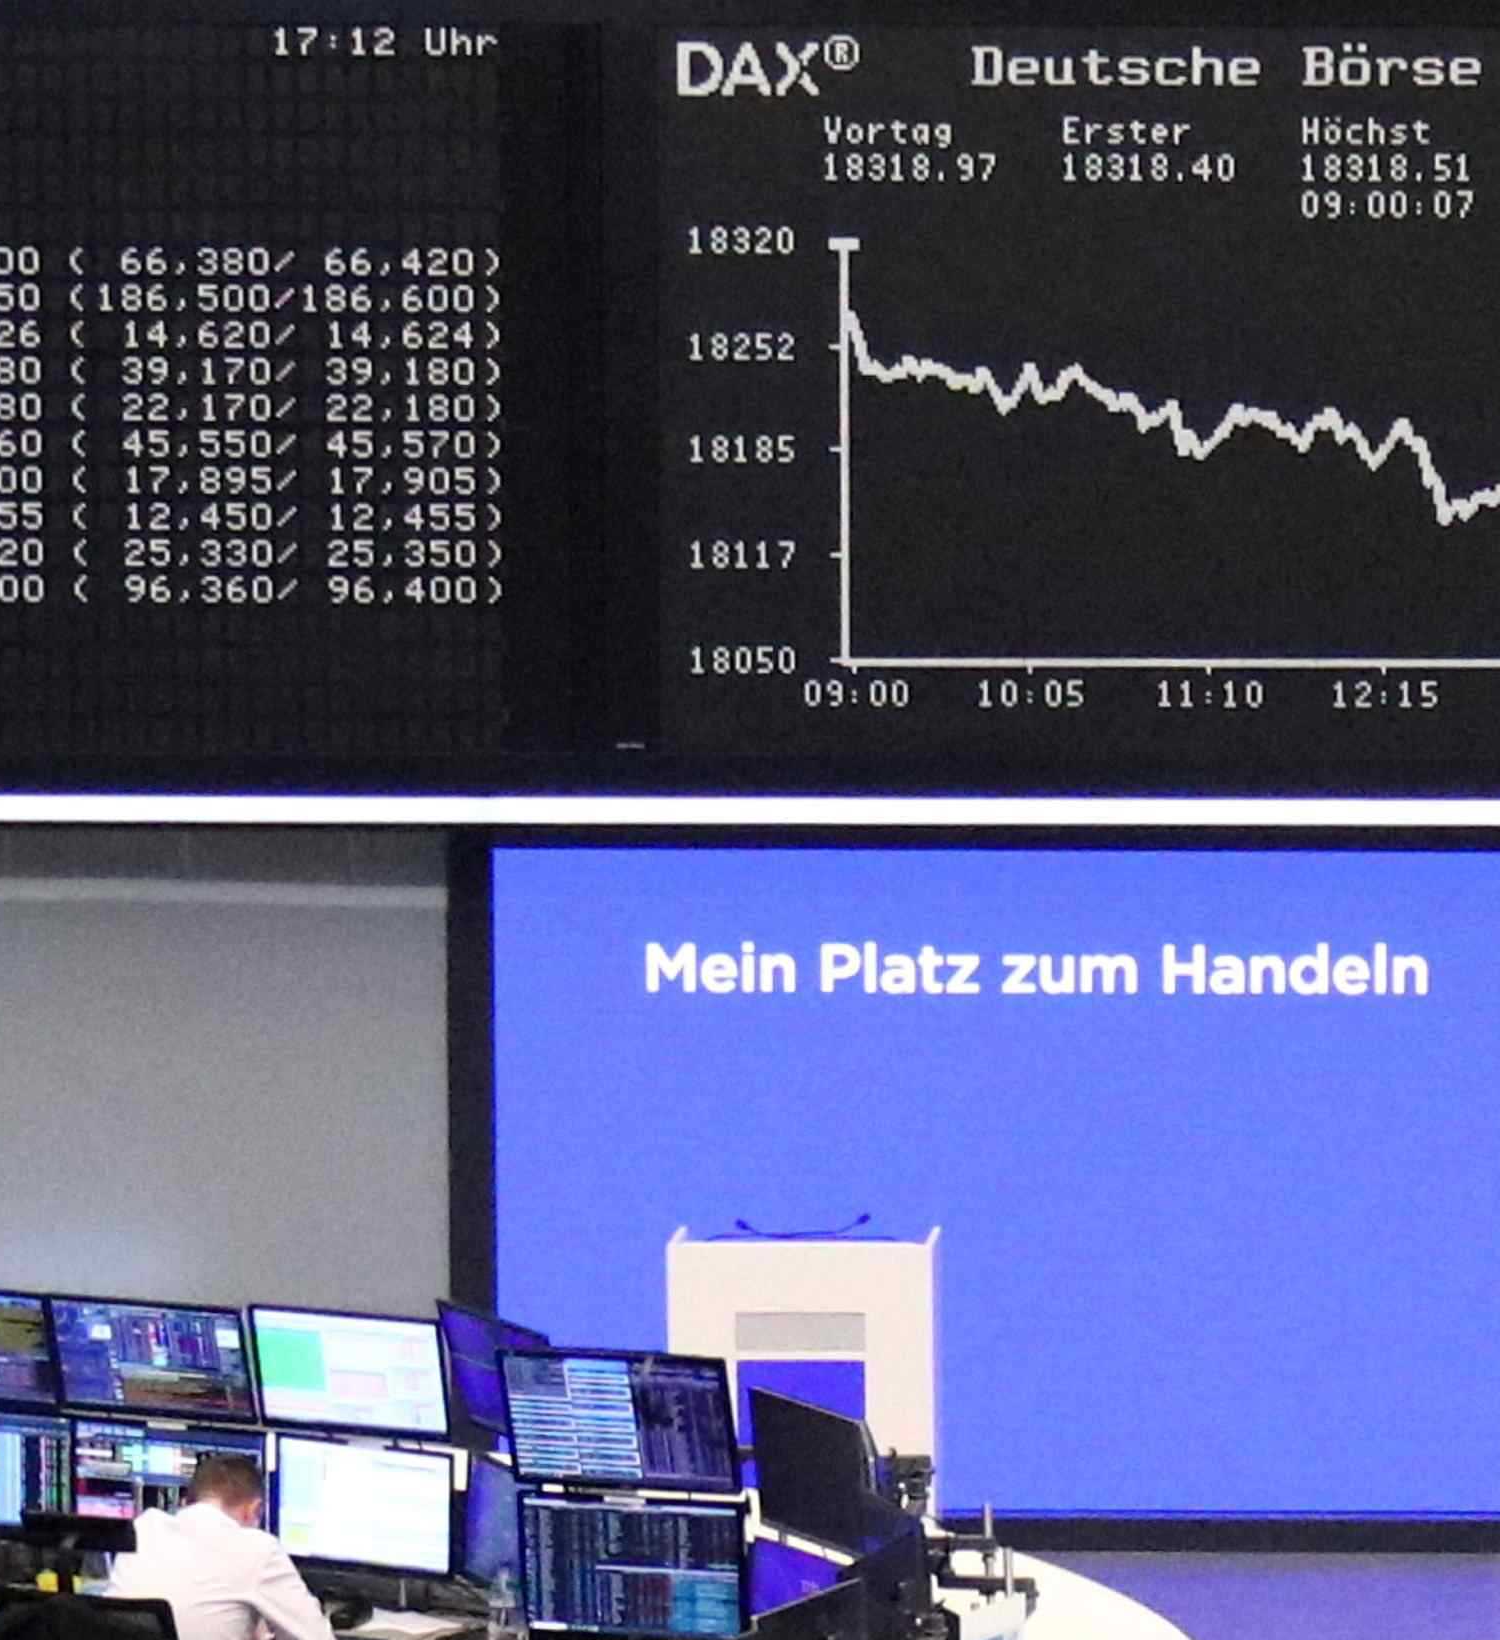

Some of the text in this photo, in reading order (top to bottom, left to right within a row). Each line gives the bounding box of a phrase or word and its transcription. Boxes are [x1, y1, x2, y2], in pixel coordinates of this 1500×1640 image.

[273, 25, 499, 57] 17:12 Uhr
[970, 44, 1262, 87] Deutsche
[1301, 41, 1483, 88] Börse
[822, 114, 953, 150] Vortag
[1061, 114, 1192, 146] Erster
[1300, 115, 1431, 146] Höchst
[823, 151, 997, 183] 18318.97
[1062, 151, 1236, 183] 18318.40
[1301, 152, 1471, 183] 18318.51
[1300, 188, 1475, 220] 09:00:07
[688, 224, 795, 256] 18320
[688, 331, 796, 362] 18252
[689, 433, 796, 464] 18185
[689, 539, 796, 570] 18117
[690, 644, 797, 676] 18050
[803, 678, 910, 708] 09:00
[978, 678, 1085, 709] 10:05
[1157, 678, 1264, 710] 11:10
[1332, 679, 1439, 710] 12:15
[644, 939, 1430, 997] Mein Platz zum Handeln
